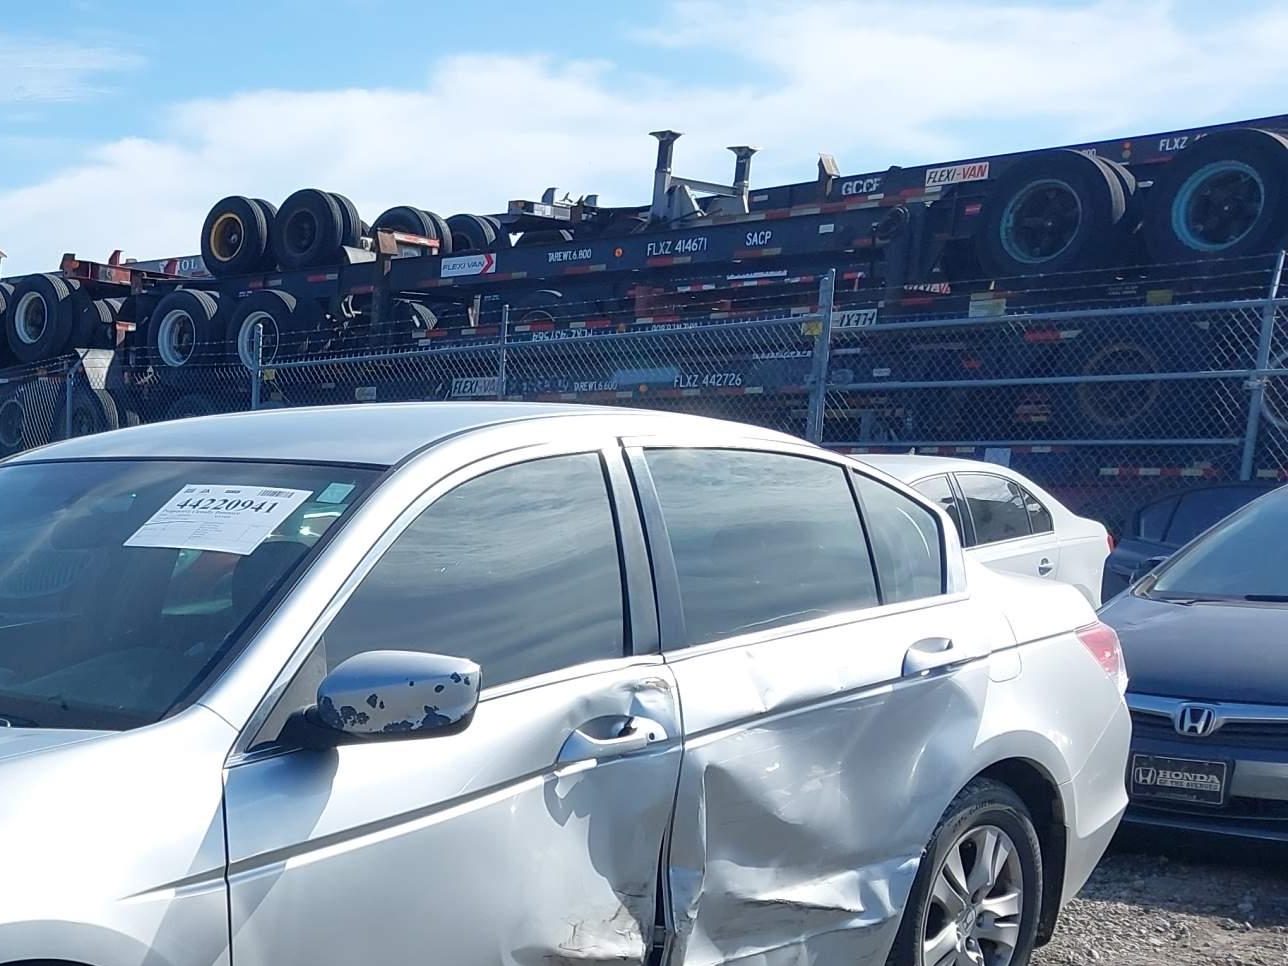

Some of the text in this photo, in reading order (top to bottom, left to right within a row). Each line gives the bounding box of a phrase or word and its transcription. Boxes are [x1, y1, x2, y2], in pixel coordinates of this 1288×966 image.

[1159, 136, 1190, 152] FLXZ
[926, 163, 988, 185] FLEXI-VAN
[745, 230, 772, 246] SACP
[646, 237, 708, 256] FLXZ 414671
[467, 260, 485, 270] VAN
[673, 372, 742, 388] FLXZ 442726
[176, 497, 279, 514] 44220941
[1158, 769, 1220, 784] HONDA
